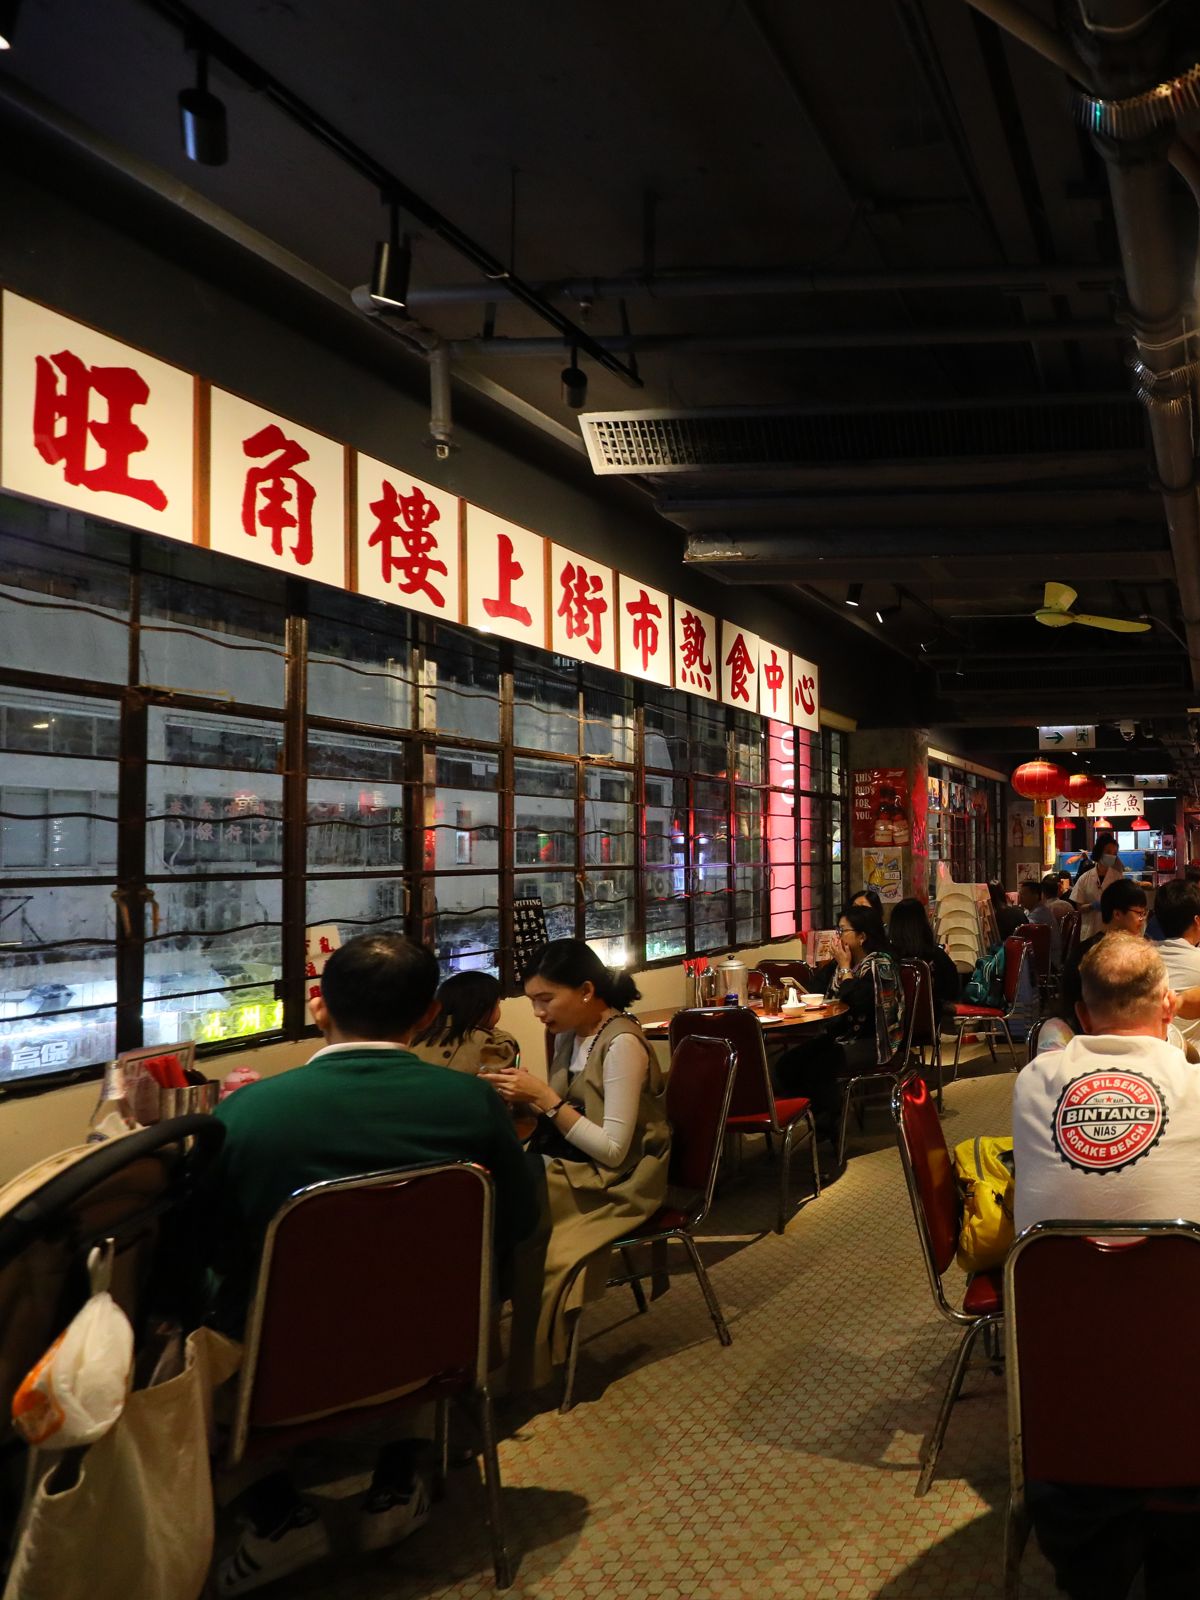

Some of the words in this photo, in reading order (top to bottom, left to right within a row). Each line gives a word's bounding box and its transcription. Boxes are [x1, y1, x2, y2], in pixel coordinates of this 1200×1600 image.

[33, 350, 816, 716] 旺角樓上街市熟食中心
[854, 773, 872, 783] THIS
[856, 811, 872, 820] YOU.
[1070, 1083, 1091, 1104] BIR
[1092, 1079, 1149, 1103] PILSENER
[1066, 1108, 1150, 1123] BINTANG
[1093, 1126, 1117, 1137] NIAS
[1067, 1129, 1107, 1158] SORAKE
[1109, 1126, 1147, 1156] BEACH
